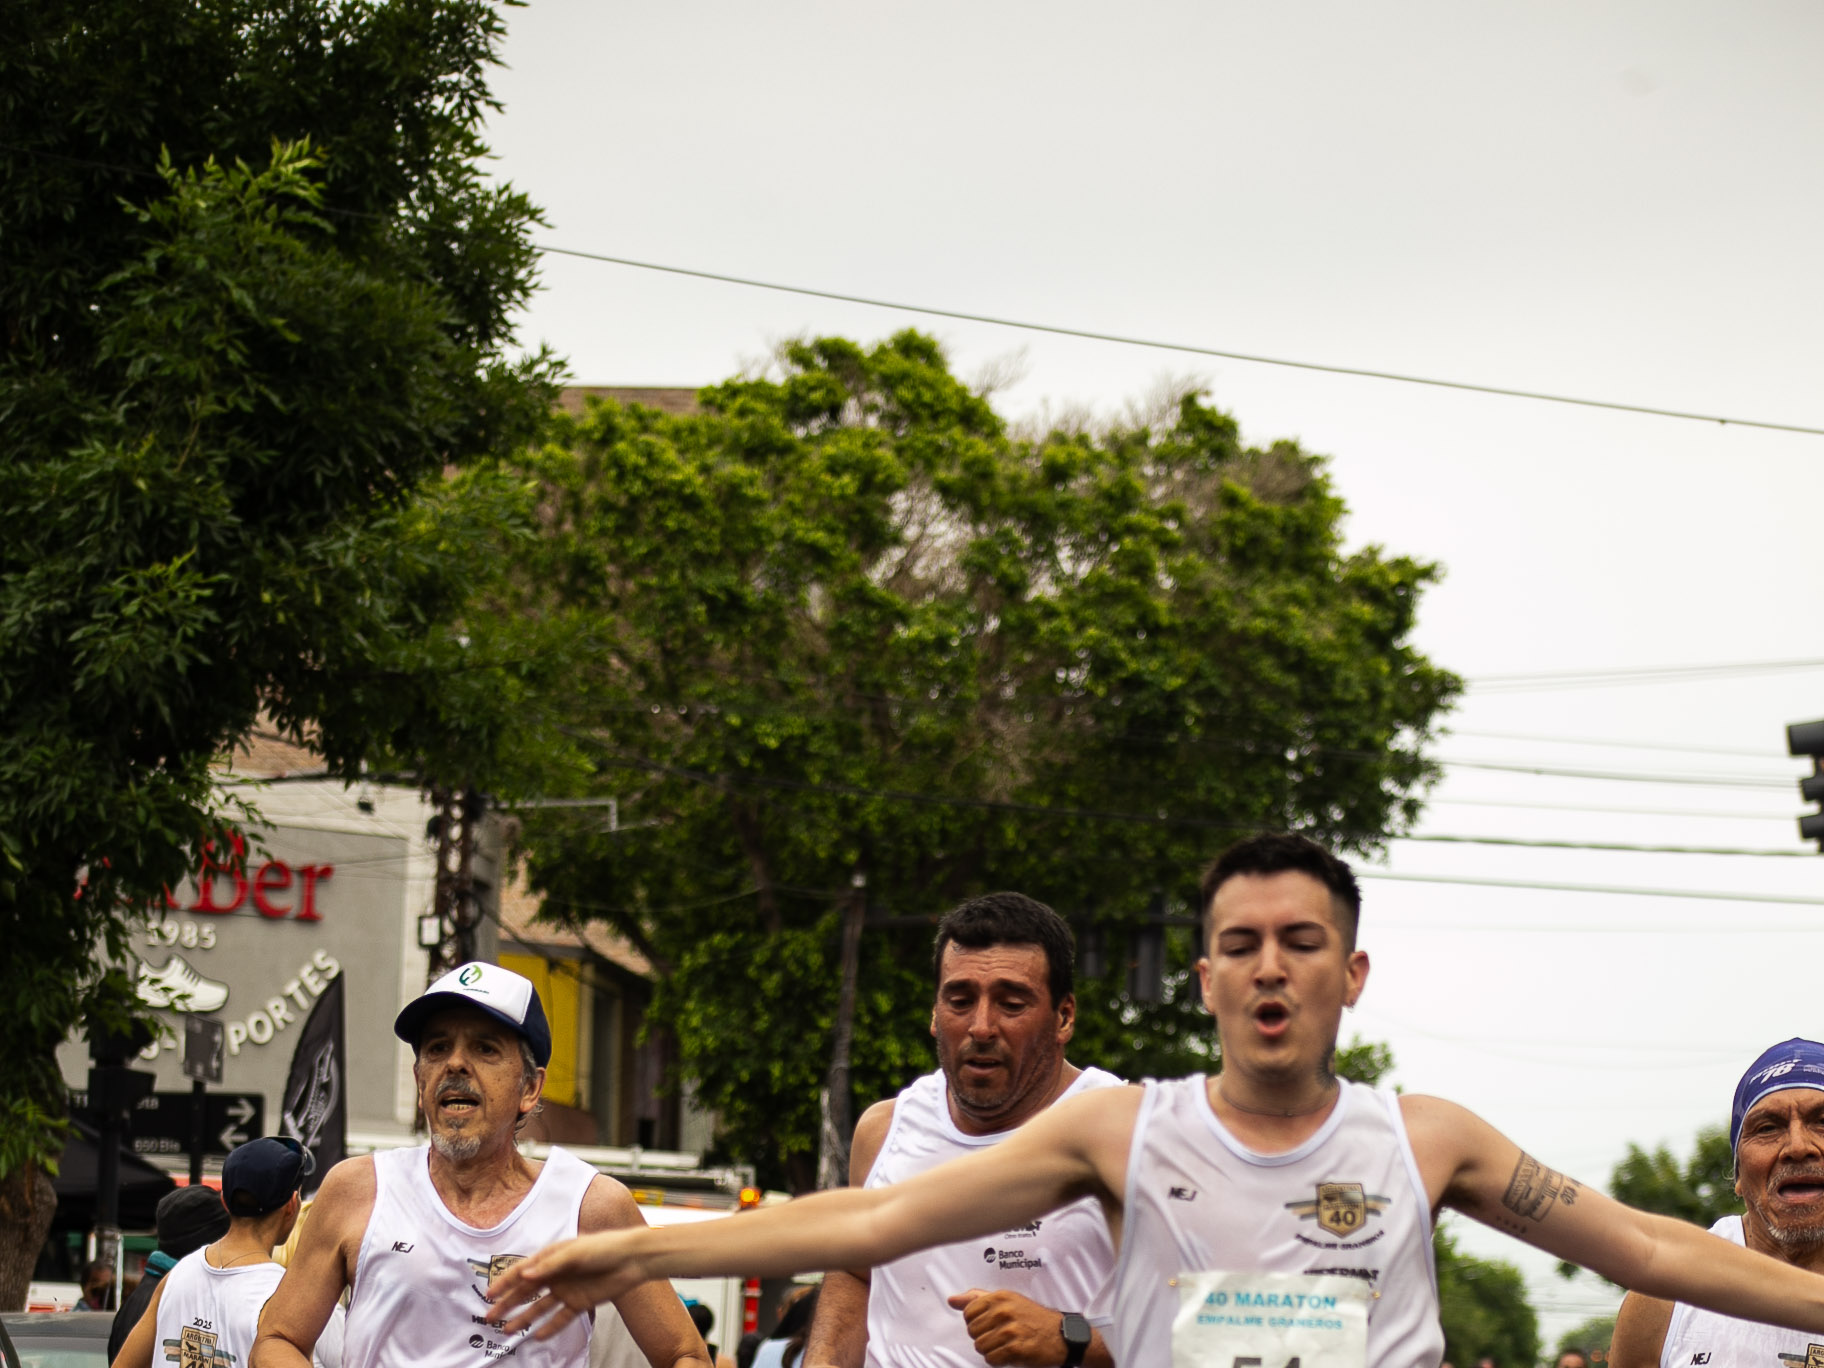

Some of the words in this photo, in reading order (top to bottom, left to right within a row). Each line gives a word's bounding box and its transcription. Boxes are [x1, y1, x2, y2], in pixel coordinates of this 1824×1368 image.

[1329, 1210, 1356, 1226] 40
[391, 1241, 415, 1253] NEJ
[999, 1250, 1024, 1259] Banco
[999, 1258, 1042, 1270] Municipal
[1205, 1292, 1228, 1307] 40
[1235, 1292, 1337, 1311] MARATON
[193, 1317, 212, 1330] 2025
[1690, 1352, 1712, 1365] NEJ
